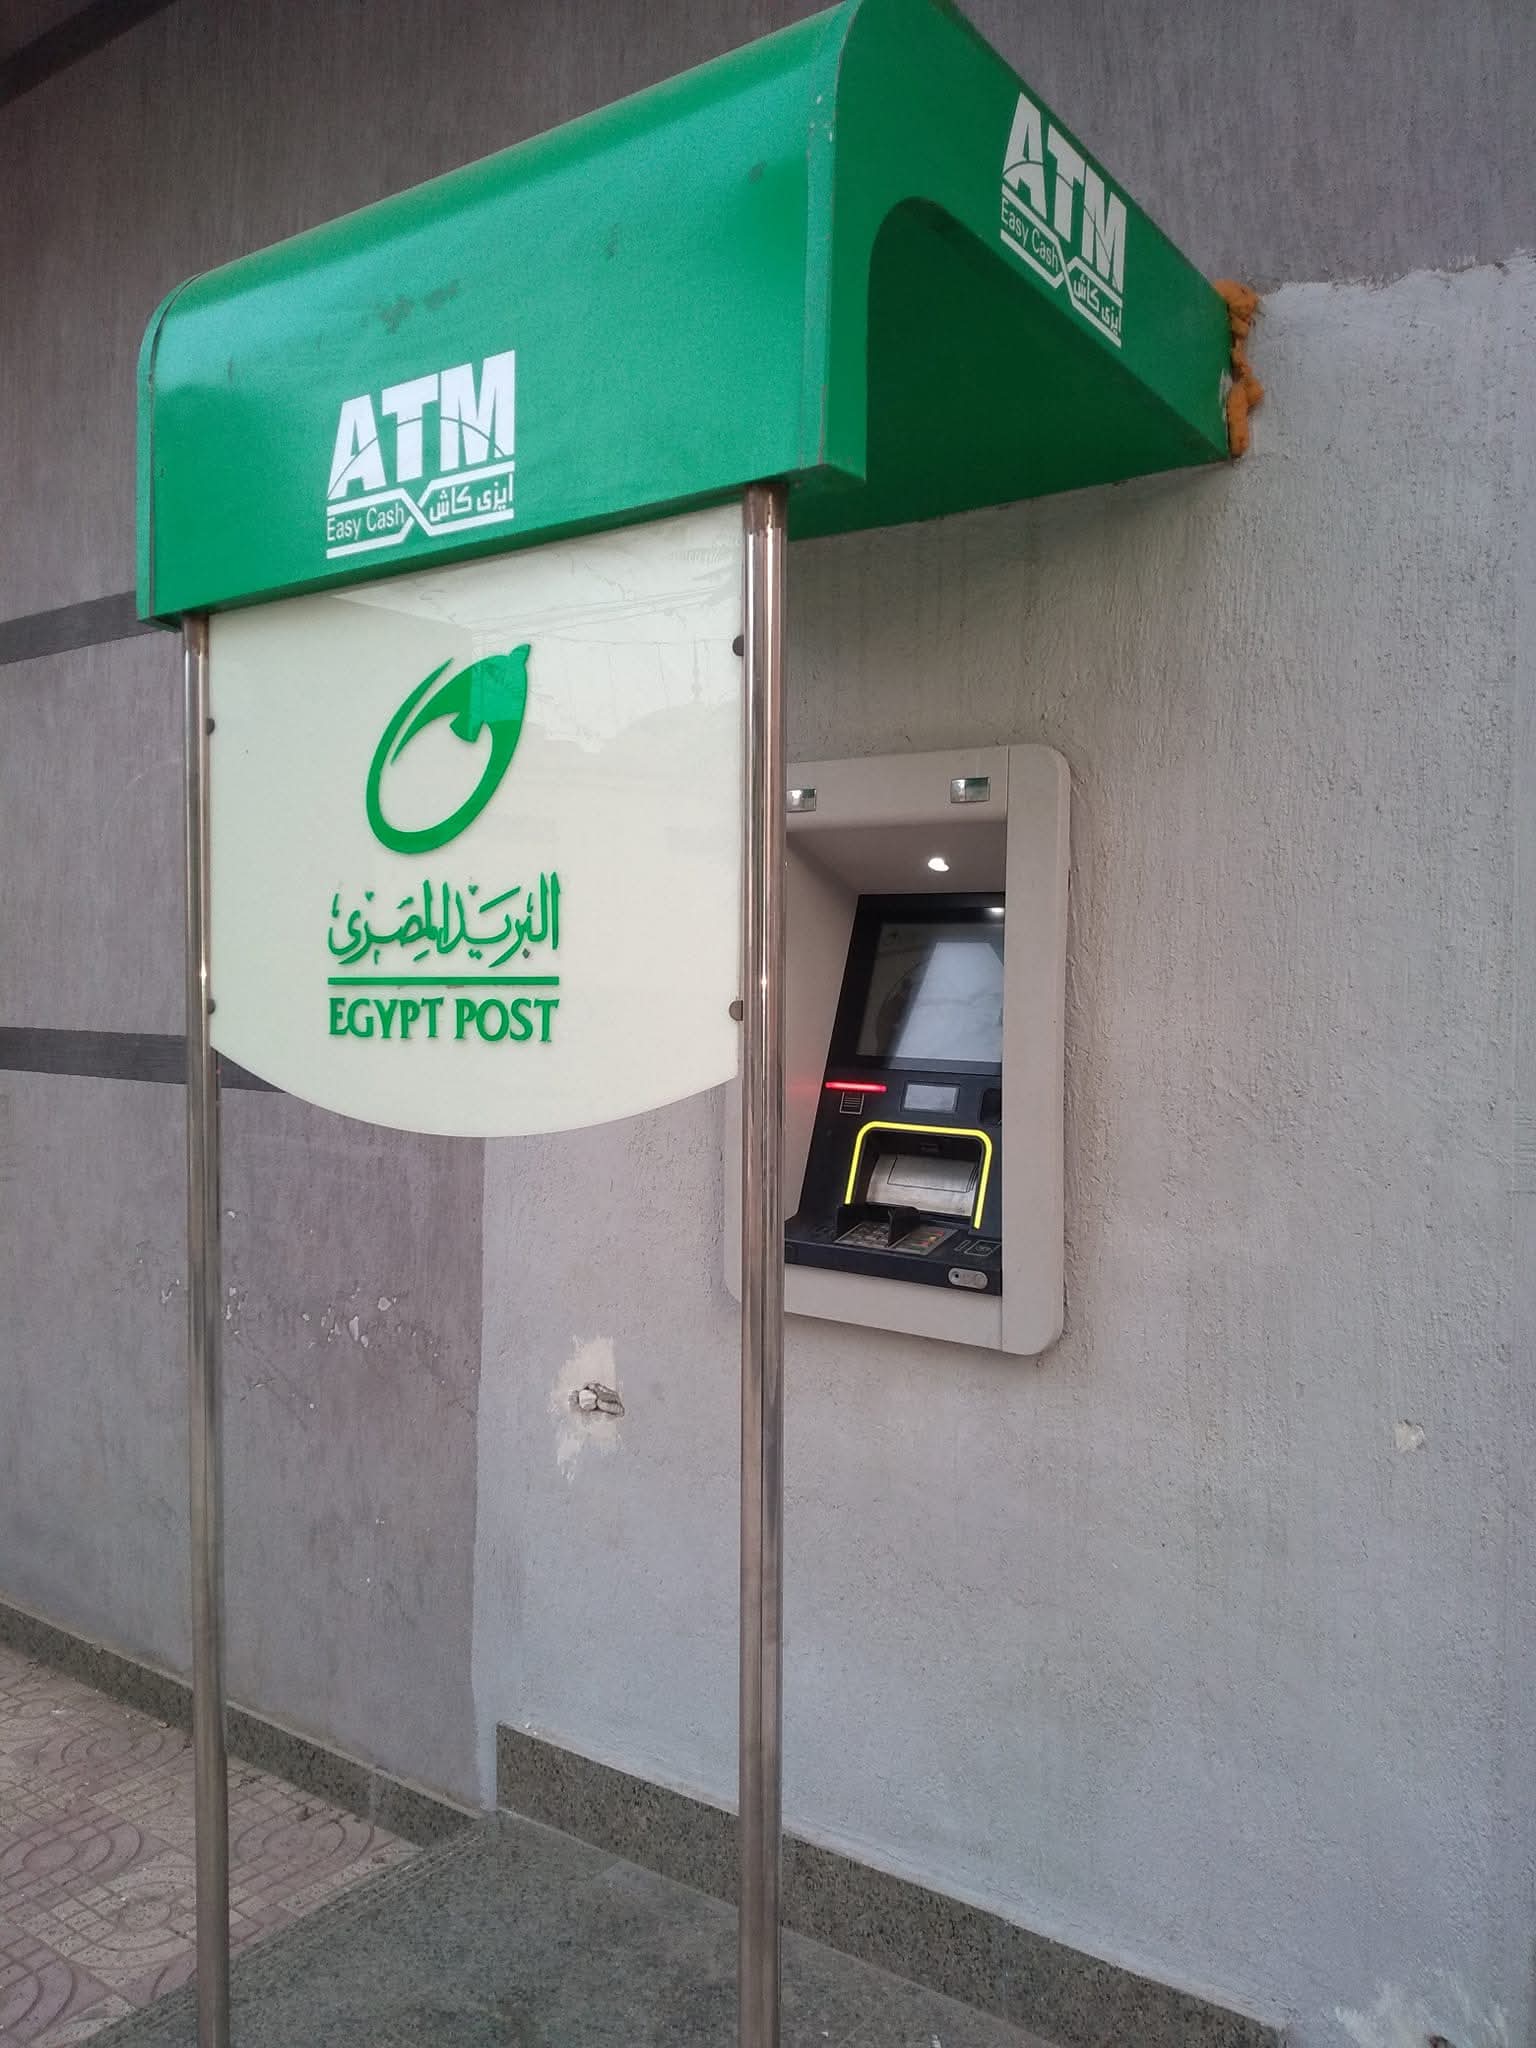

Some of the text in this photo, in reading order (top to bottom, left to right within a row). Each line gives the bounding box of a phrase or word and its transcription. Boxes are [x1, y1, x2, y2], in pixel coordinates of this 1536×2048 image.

[1002, 92, 1127, 294] ATM
[1001, 197, 1059, 273] Easy Cash
[1073, 270, 1100, 313] كاش
[327, 350, 515, 500] ATM
[327, 503, 406, 542] Easy Cash
[429, 486, 473, 522] كاش
[329, 997, 560, 1043] EGYPT POST
